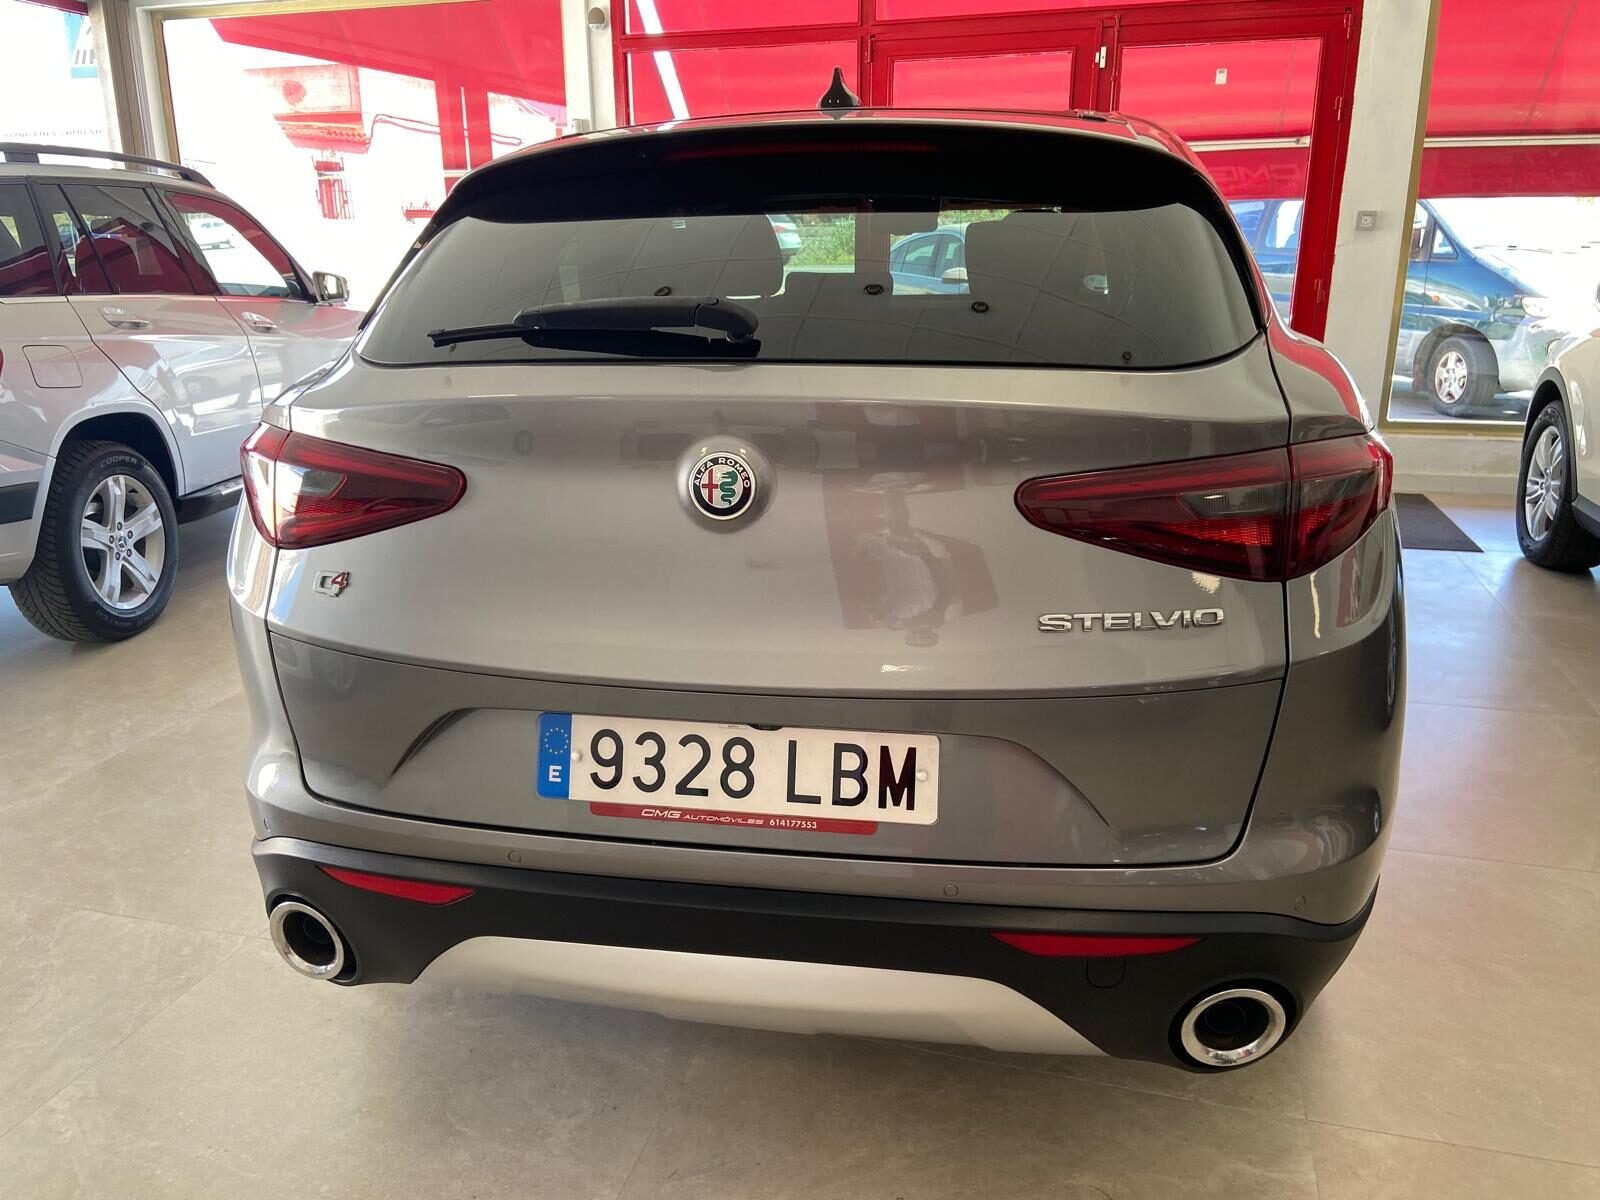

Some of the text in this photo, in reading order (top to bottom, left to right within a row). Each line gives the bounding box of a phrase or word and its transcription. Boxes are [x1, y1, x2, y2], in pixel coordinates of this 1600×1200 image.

[100, 454, 138, 469] COOPER
[694, 457, 751, 488] ALFA ROMEO
[312, 569, 350, 598] Q4
[1038, 608, 1225, 633] STELVIO
[548, 765, 562, 783] E
[589, 728, 918, 811] 9328 LBM
[640, 808, 818, 830] CMG AUTOMÓVILES 614177553
